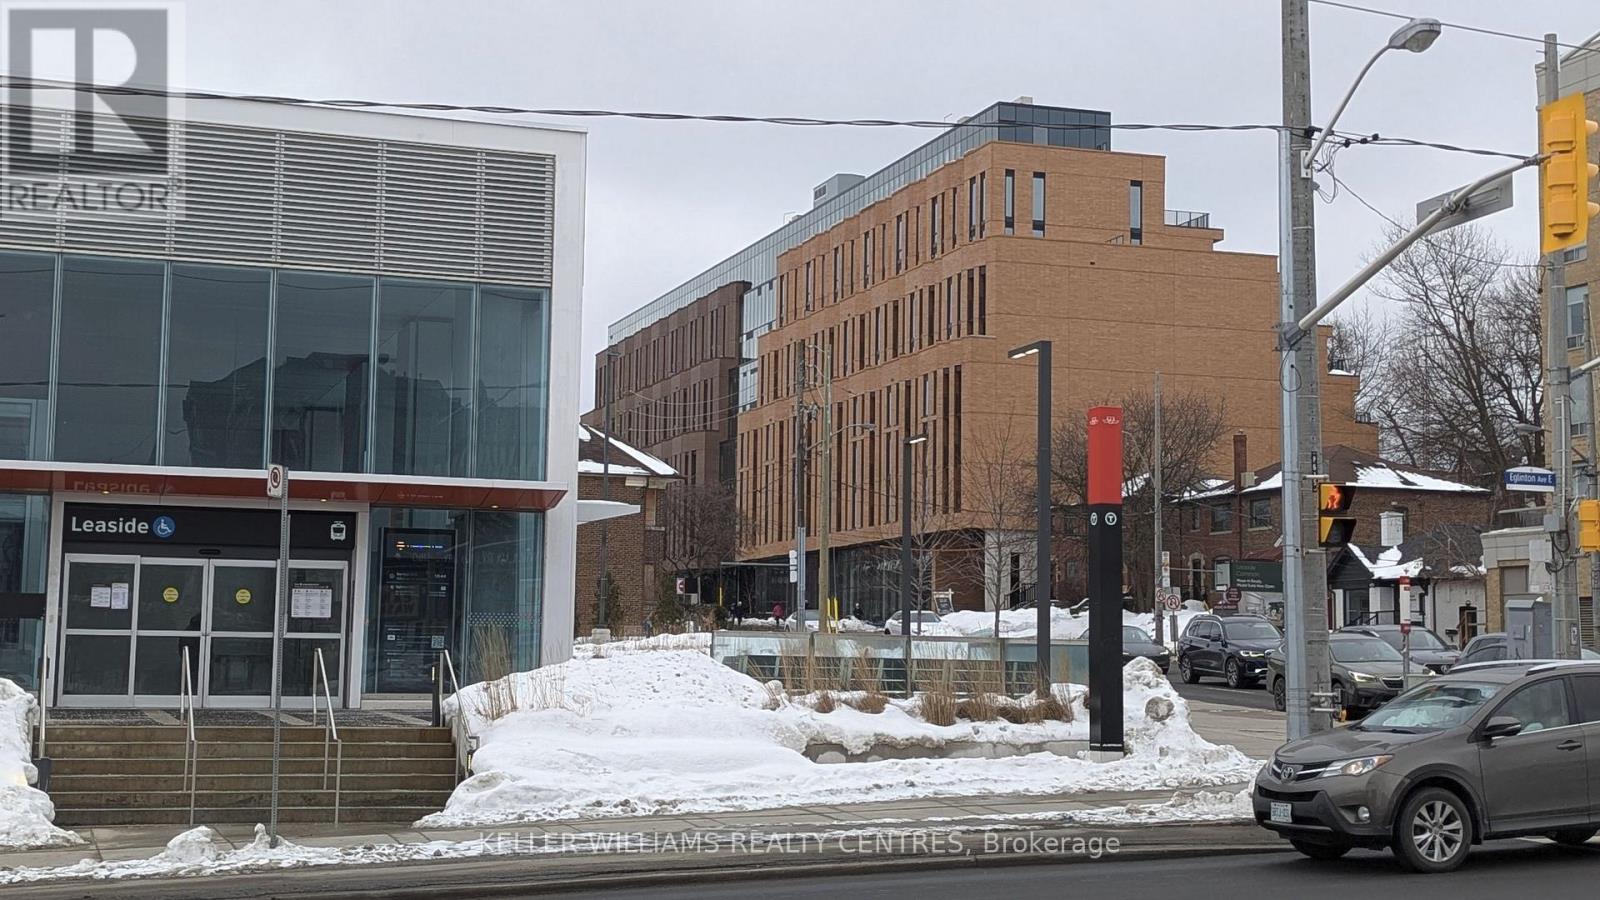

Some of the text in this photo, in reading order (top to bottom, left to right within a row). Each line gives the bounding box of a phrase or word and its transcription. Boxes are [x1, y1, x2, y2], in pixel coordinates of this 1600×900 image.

[1510, 473, 1536, 483] Eglinton
[1548, 474, 1552, 484] E
[71, 516, 149, 534] Leaside
